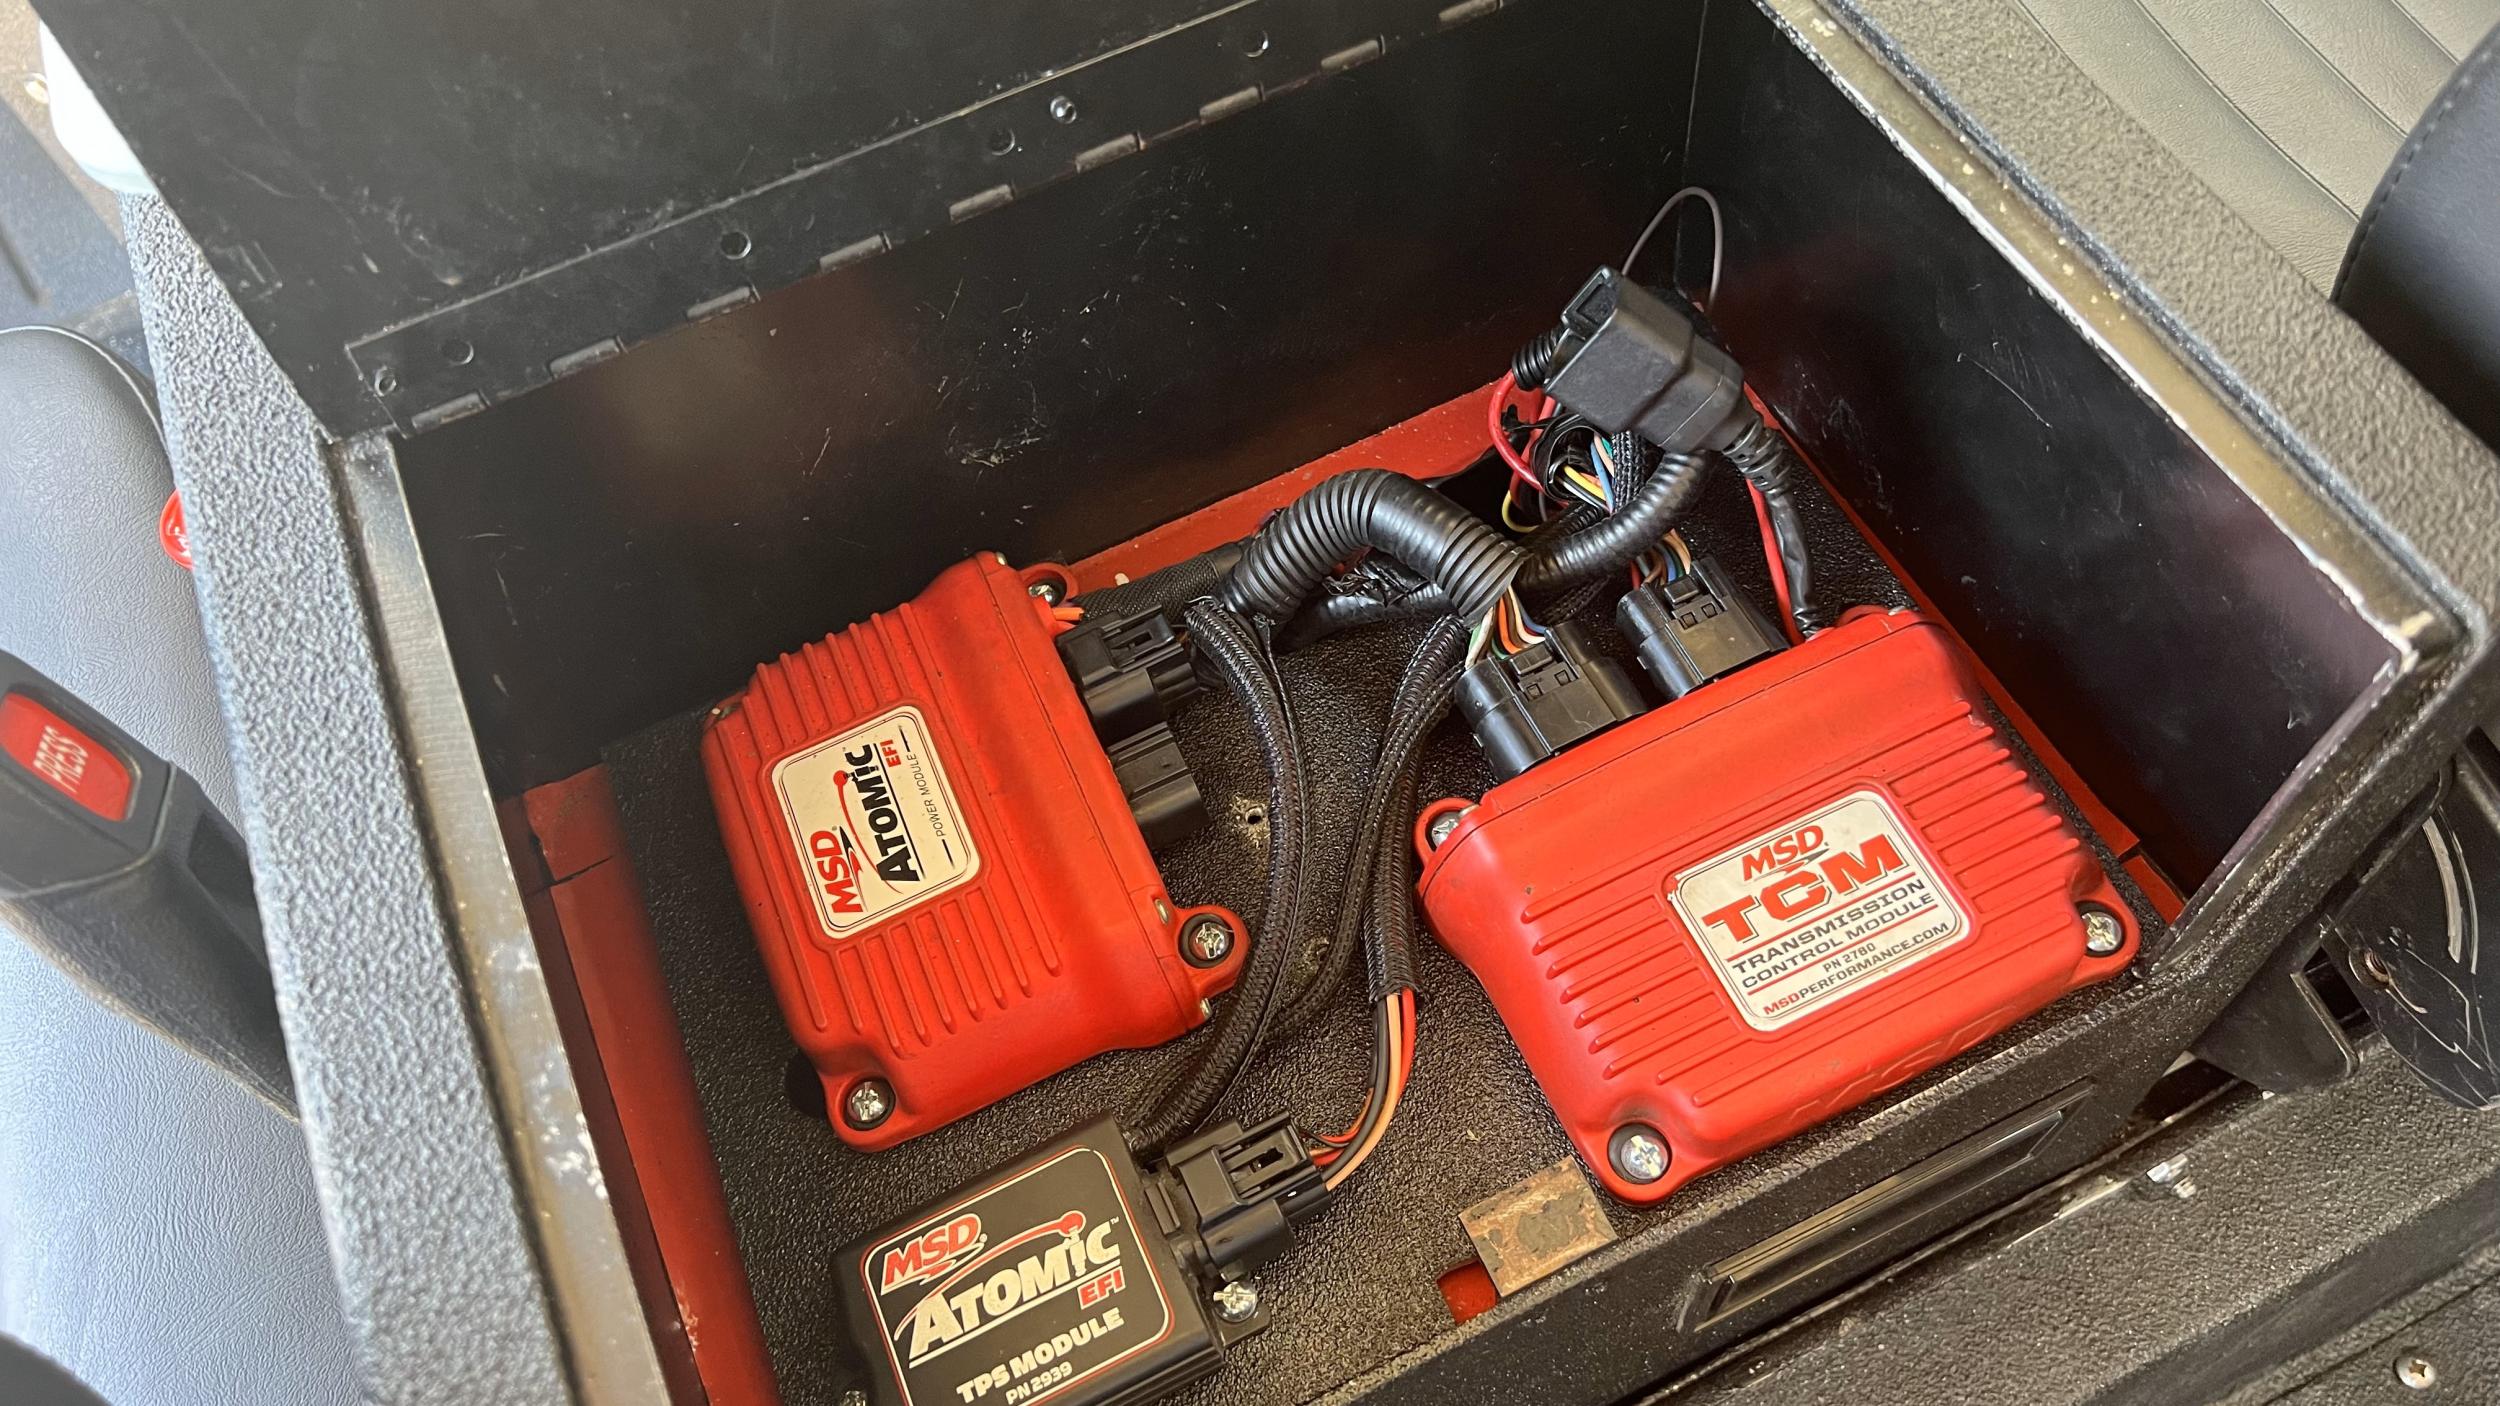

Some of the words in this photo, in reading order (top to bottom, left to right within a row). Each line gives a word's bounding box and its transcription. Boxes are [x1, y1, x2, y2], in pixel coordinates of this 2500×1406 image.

[33, 725, 89, 793] PRESS
[880, 739, 902, 768] EFI
[906, 753, 930, 796] MODULE
[924, 799, 946, 837] POWER
[810, 830, 863, 913] MSD
[1743, 825, 1824, 881] MSD
[1701, 834, 1909, 944] TCM
[1732, 879, 1926, 974] TRANSMISSION
[1742, 936, 1843, 990] CONTROL
[1847, 892, 1935, 940] MODULE
[1823, 957, 1841, 973] PN
[1844, 942, 1877, 964] 2780
[1763, 922, 1950, 1015] MSDPERFORMANCE.COM
[882, 1213, 982, 1295] MSD
[1077, 1266, 1127, 1310] EFI
[956, 1363, 1011, 1405] TPS
[1012, 1307, 1125, 1375] MODULE
[1005, 1382, 1031, 1405] PN
[1031, 1361, 1073, 1391] 2939
